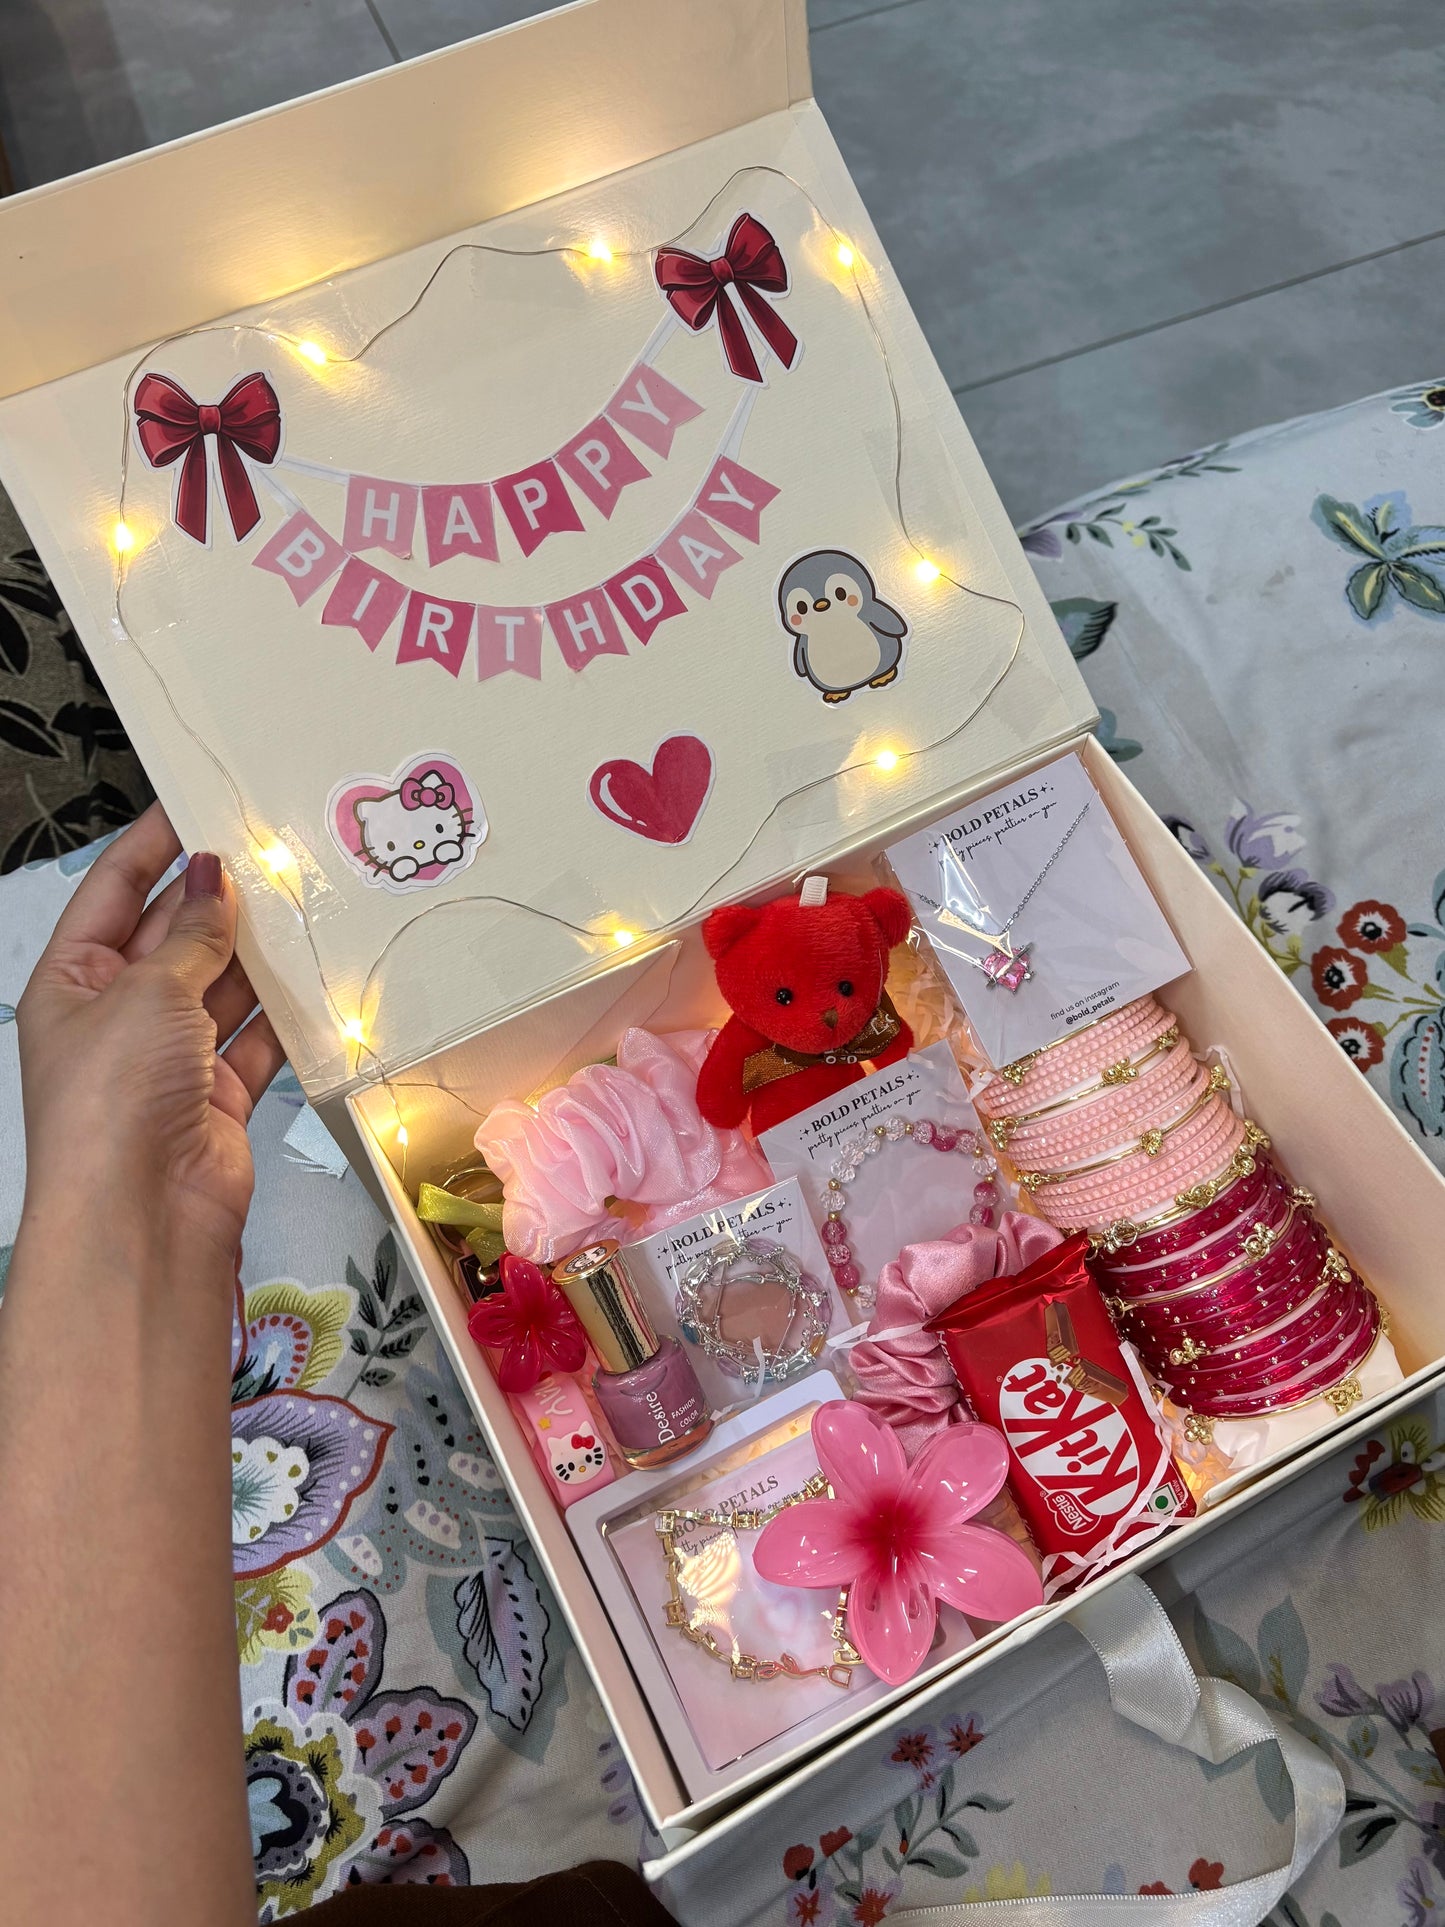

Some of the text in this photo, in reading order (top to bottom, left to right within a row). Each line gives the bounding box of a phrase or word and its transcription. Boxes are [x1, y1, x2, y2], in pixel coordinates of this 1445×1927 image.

[361, 379, 671, 545] HAPPY
[275, 472, 757, 662] BIRTHDAY
[941, 788, 1039, 846] BOLD PETALS
[1050, 981, 1120, 1020] find us on instagram
[1065, 995, 1116, 1025] @bold_petals
[811, 1075, 905, 1132] BOLD PETALS
[808, 1133, 832, 1160] pretty
[671, 1202, 775, 1251] BOLD PETALS
[646, 1391, 676, 1445] Desire
[671, 1397, 696, 1419] FASHION
[680, 1410, 699, 1428] COLOR
[718, 1475, 779, 1515] PETALS
